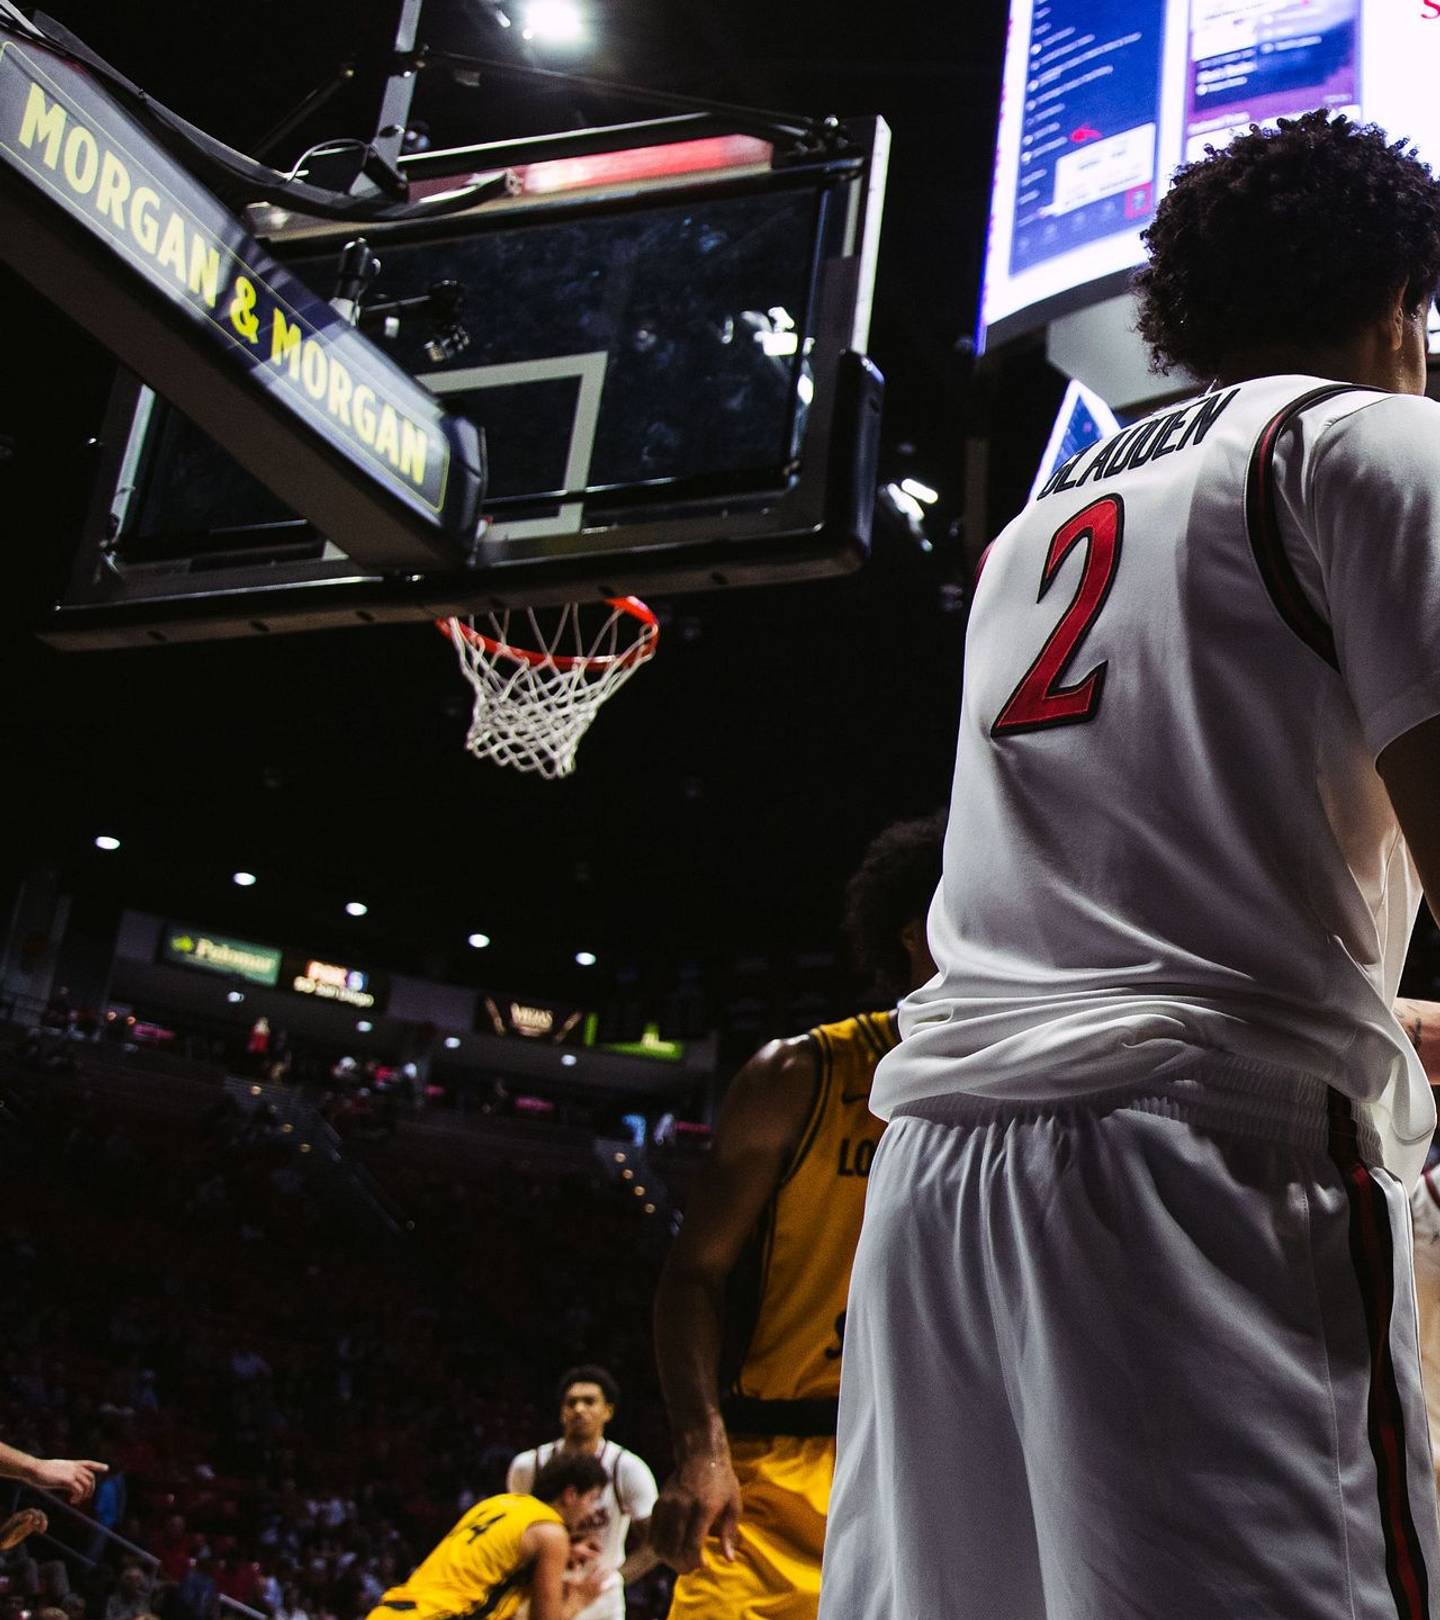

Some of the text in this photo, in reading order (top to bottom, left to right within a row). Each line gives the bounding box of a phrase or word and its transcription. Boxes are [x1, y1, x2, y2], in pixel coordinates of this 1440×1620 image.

[18, 83, 429, 486] MORGAN & MORGAN
[990, 492, 1124, 737] 2
